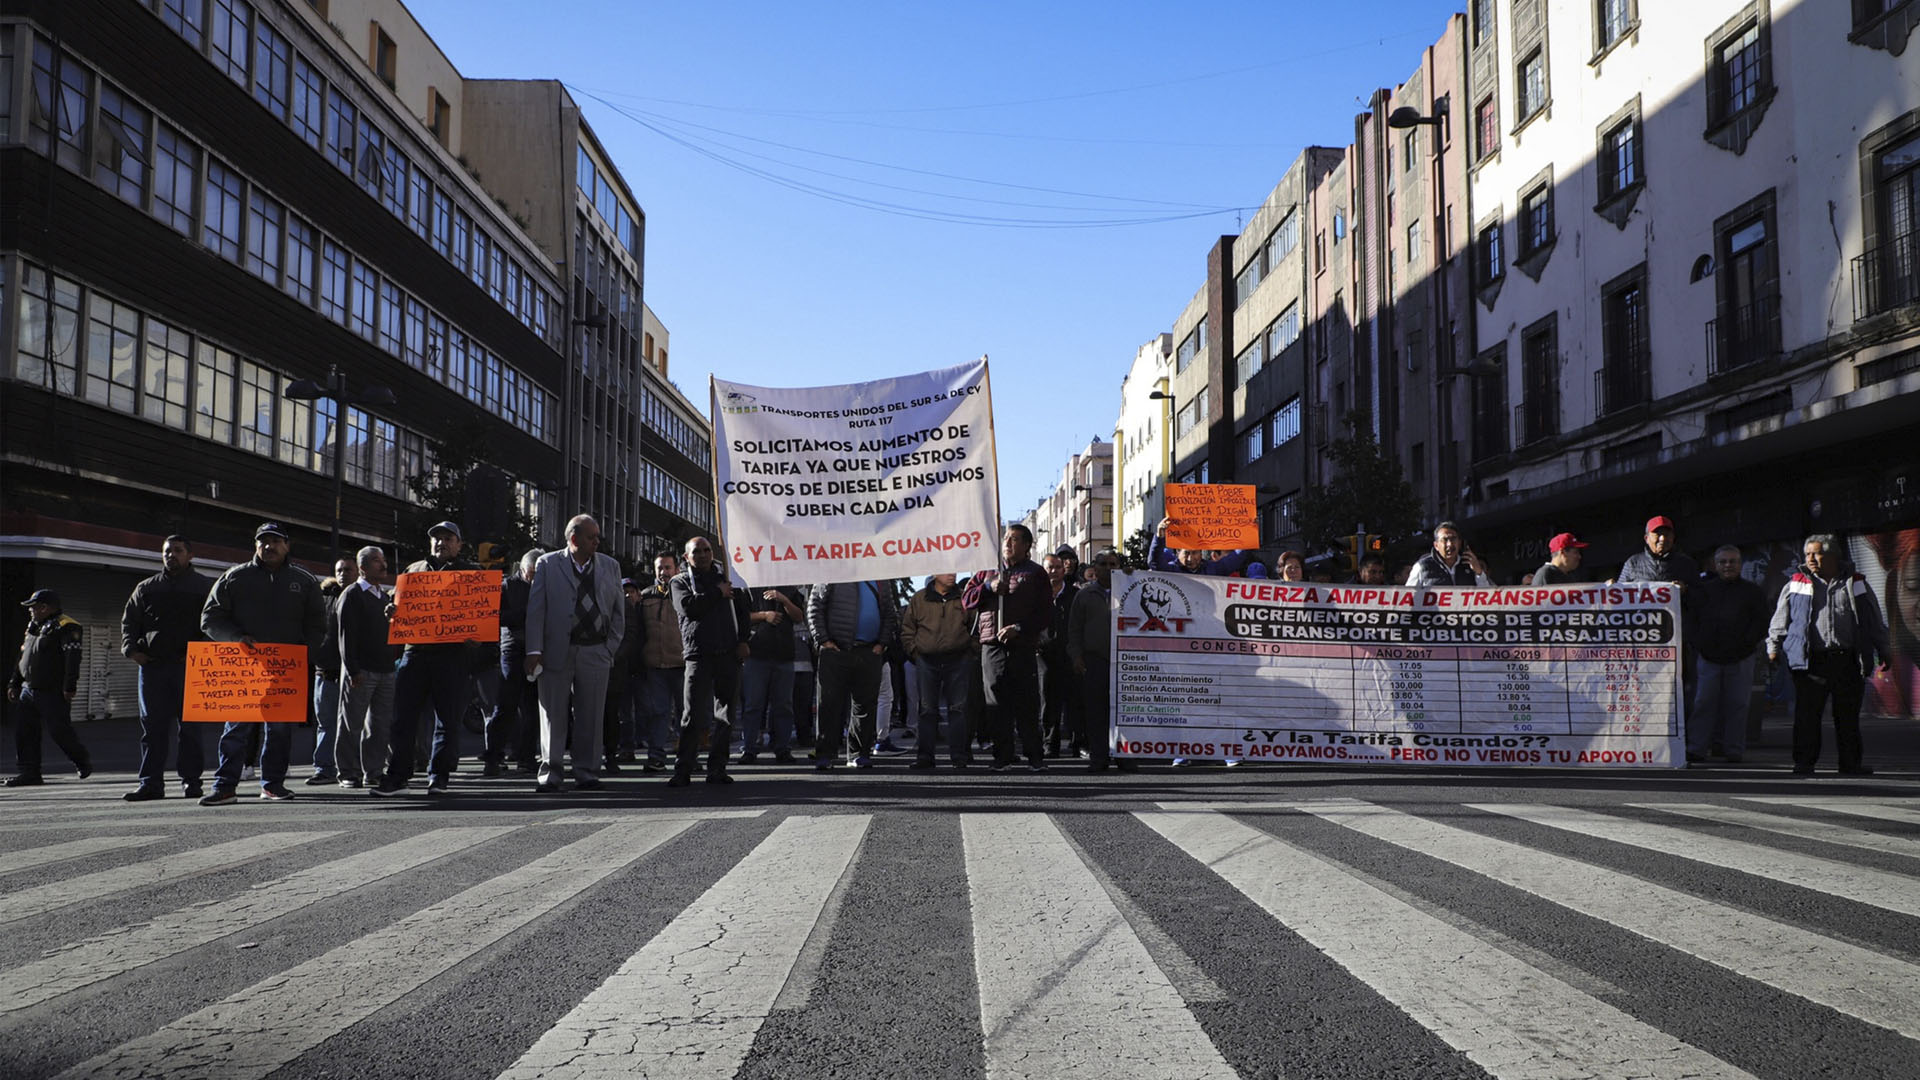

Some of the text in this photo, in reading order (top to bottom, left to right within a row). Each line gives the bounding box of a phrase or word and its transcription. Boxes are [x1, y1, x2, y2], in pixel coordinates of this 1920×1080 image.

[761, 404, 840, 419] TRANSPORTES
[842, 406, 885, 418] UNIDOS
[887, 401, 908, 413] DEL
[911, 396, 932, 408] SUR
[934, 393, 948, 403] SA
[950, 388, 964, 398] DE
[967, 385, 982, 395] CV
[849, 416, 893, 429] RUTA 117
[734, 424, 970, 454] SOLICITAMOS AUMENTO DE
[741, 447, 966, 475] TARIFA YA QUE NUESTROS
[723, 467, 985, 496] COSTOS DE DIESEL E INSUMOS
[786, 495, 935, 517] SUBEN CADA DIA
[770, 544, 798, 561] LA
[803, 542, 877, 559] TARIFA
[882, 531, 982, 556] CUANDO?
[404, 574, 442, 585] TARIFA
[1226, 583, 1672, 607] FUERZA AMPLIA DE TRANSPORTISTAS
[404, 602, 443, 612] TARIFA
[1117, 616, 1193, 632] FAT
[1234, 607, 1662, 626] INCREMENTOS DE COSTOS DE OPERACIÓN
[1237, 624, 1661, 642] DE TRANSPORTE PÚBLICO DE PASAJEROS
[211, 644, 240, 655] TODO
[1190, 641, 1281, 654] CONCEPTO
[1376, 648, 1403, 659] AÑO
[1406, 649, 1432, 659] 2017
[1514, 650, 1541, 660] 2019
[1572, 650, 1582, 659] %
[1587, 650, 1671, 660] INCREMENTO
[200, 657, 213, 667] LA
[219, 656, 259, 667] TARIFA
[1121, 653, 1148, 662] Diesel
[1400, 662, 1422, 670] 17.05
[1506, 663, 1529, 671] 17.05
[1121, 664, 1160, 672] Gasolina
[199, 669, 236, 678] TARIFA
[241, 669, 254, 677] EN
[1121, 673, 1147, 682] Costo
[1150, 675, 1213, 684] Mantenimiento
[198, 690, 233, 698] TARIFA
[238, 688, 247, 696] EN
[1121, 684, 1158, 692] Inflación
[1160, 685, 1209, 694] Acumulada
[1521, 693, 1531, 701] %
[1121, 694, 1151, 703] Salario
[1187, 696, 1221, 704] General
[1121, 705, 1145, 713] Tarifa
[1121, 715, 1145, 723] Tarifa
[1147, 716, 1187, 725] Vagoneta
[1243, 730, 1550, 748] ¿Y la Tarifa Cuando??
[1116, 741, 1215, 756] NOSOTROS
[1221, 744, 1243, 756] TE
[1391, 748, 1438, 761] PERO
[1444, 749, 1470, 762] NO
[1476, 749, 1541, 763] VEMOS
[1546, 750, 1571, 763] TU
[1577, 751, 1637, 763] APOYO
